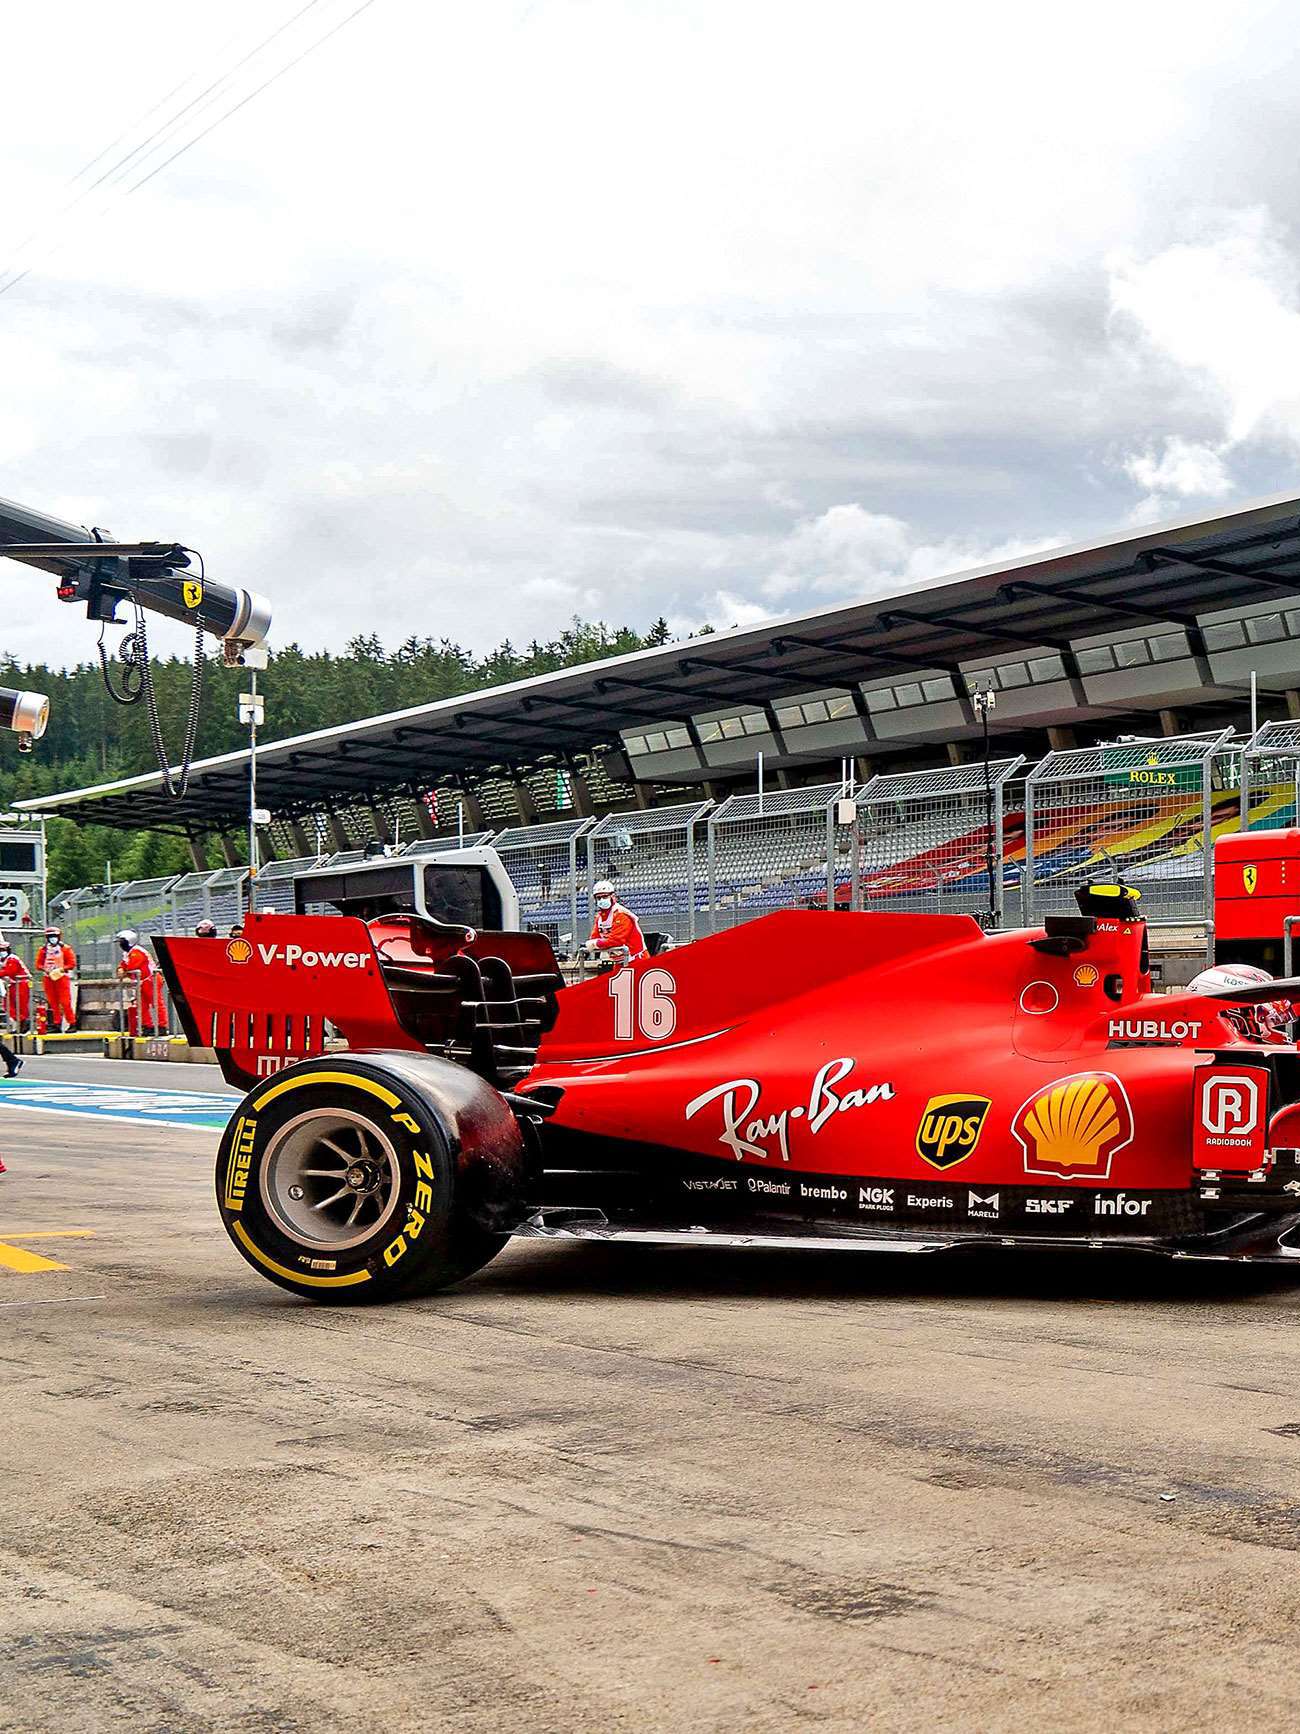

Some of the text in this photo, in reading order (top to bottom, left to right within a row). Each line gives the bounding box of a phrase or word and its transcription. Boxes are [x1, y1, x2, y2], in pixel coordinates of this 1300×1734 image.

[1130, 771, 1177, 785] ROLEX
[257, 943, 371, 968] V-Power
[608, 968, 677, 1041] 16
[1108, 1020, 1202, 1039] HUBLOT
[922, 1115, 980, 1157] ups
[1206, 1137, 1252, 1147] RADIOBOOK
[224, 1116, 258, 1212] PIRELLI
[757, 1180, 791, 1195] Palantir
[800, 1183, 848, 1200] brembo
[859, 1187, 895, 1204] NGK
[859, 1203, 894, 1212] SPARK PLUGS
[907, 1194, 954, 1209] Experis
[1025, 1198, 1074, 1213] SKF
[1094, 1193, 1152, 1215] infor
[967, 1210, 999, 1219] MARELLI
